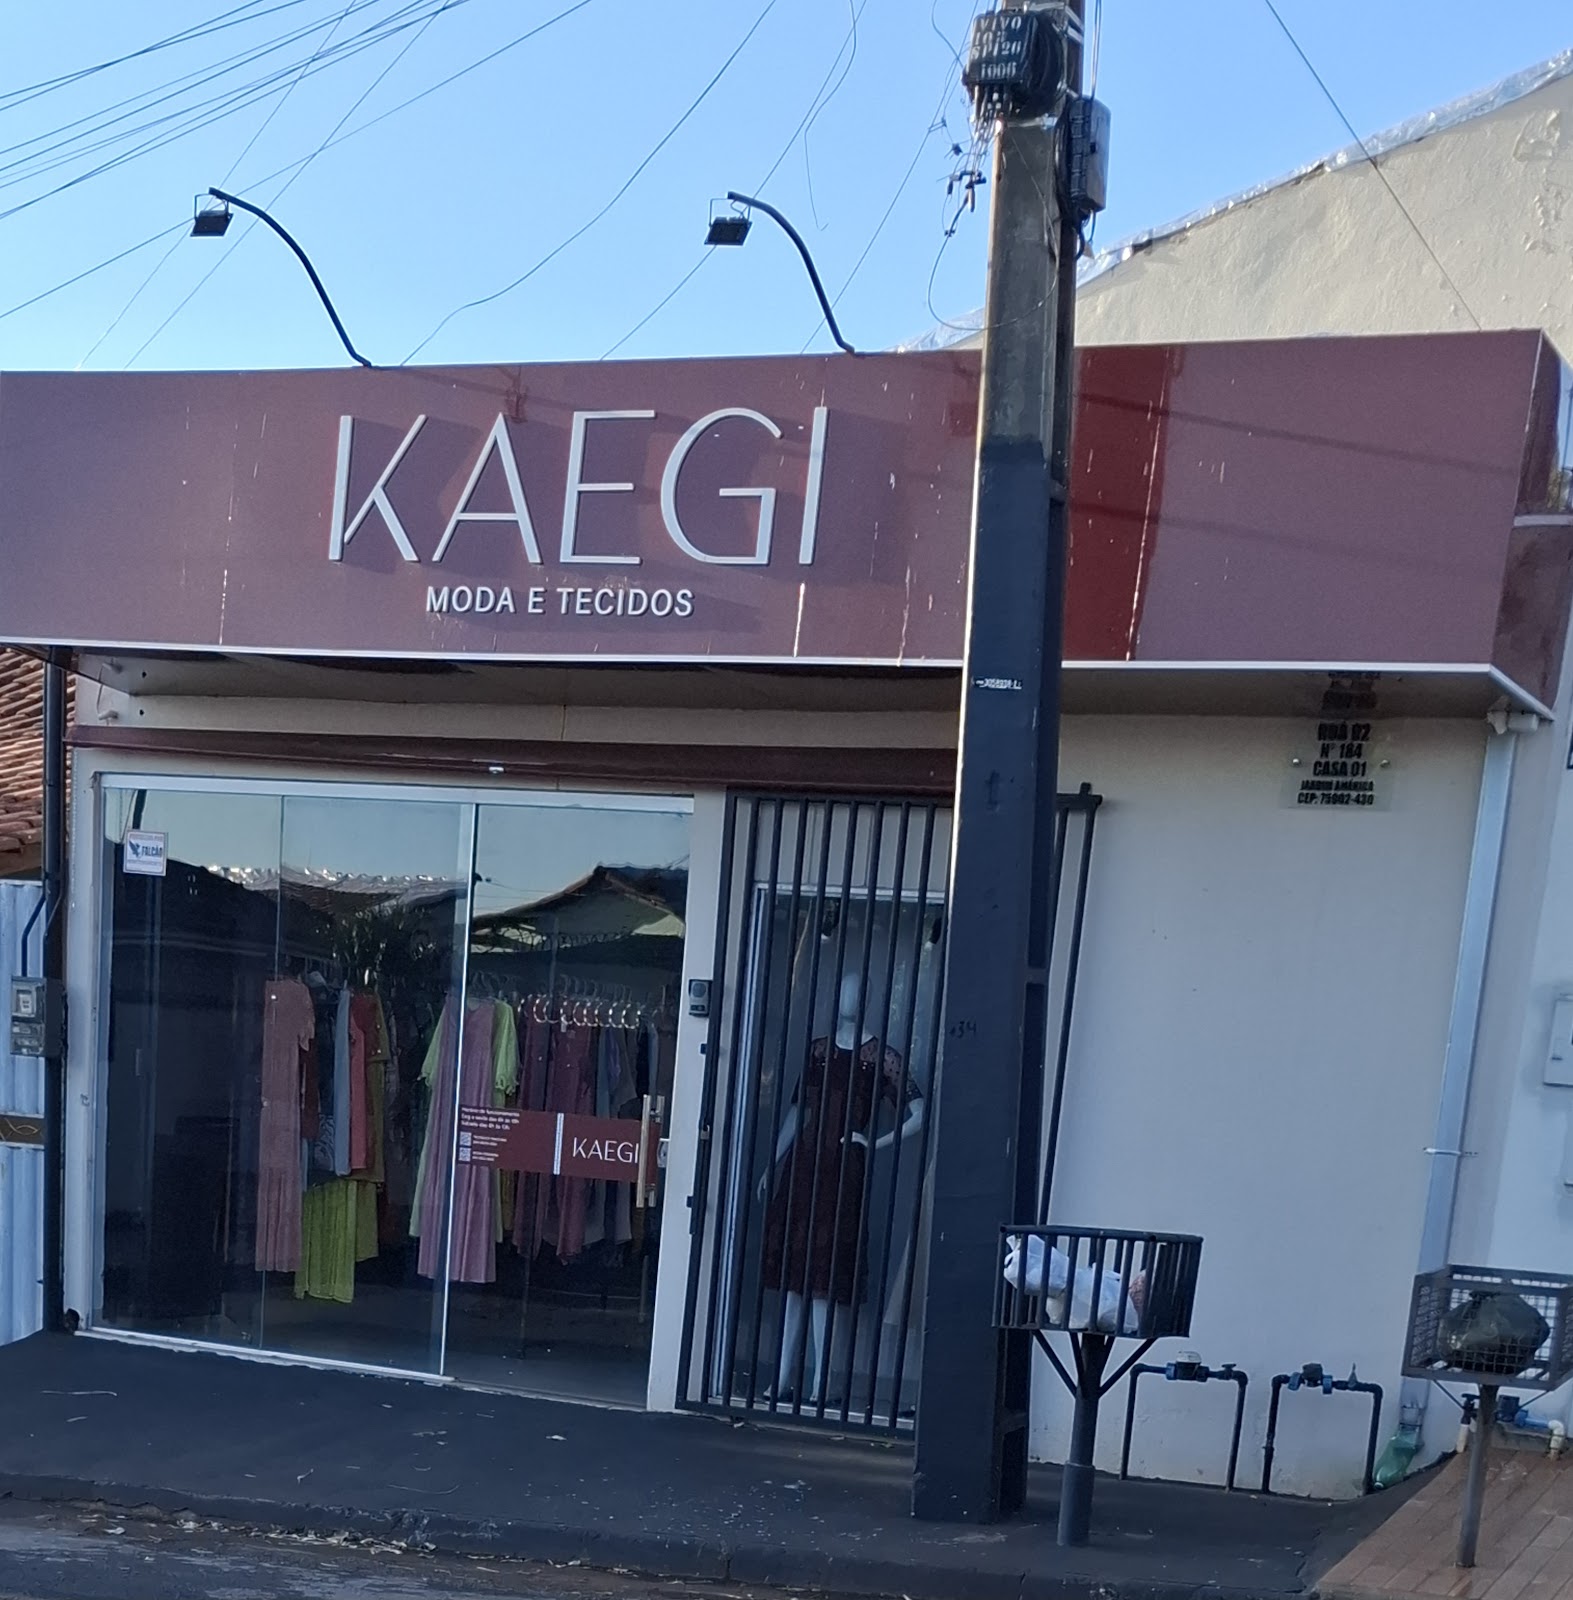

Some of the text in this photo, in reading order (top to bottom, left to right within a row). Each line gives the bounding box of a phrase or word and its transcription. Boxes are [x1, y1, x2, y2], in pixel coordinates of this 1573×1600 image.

[328, 405, 828, 565] KAEGI
[425, 586, 694, 617] MODA E TECIDOS
[1313, 761, 1368, 777] CASA 01
[572, 1136, 639, 1164] KAEGI
